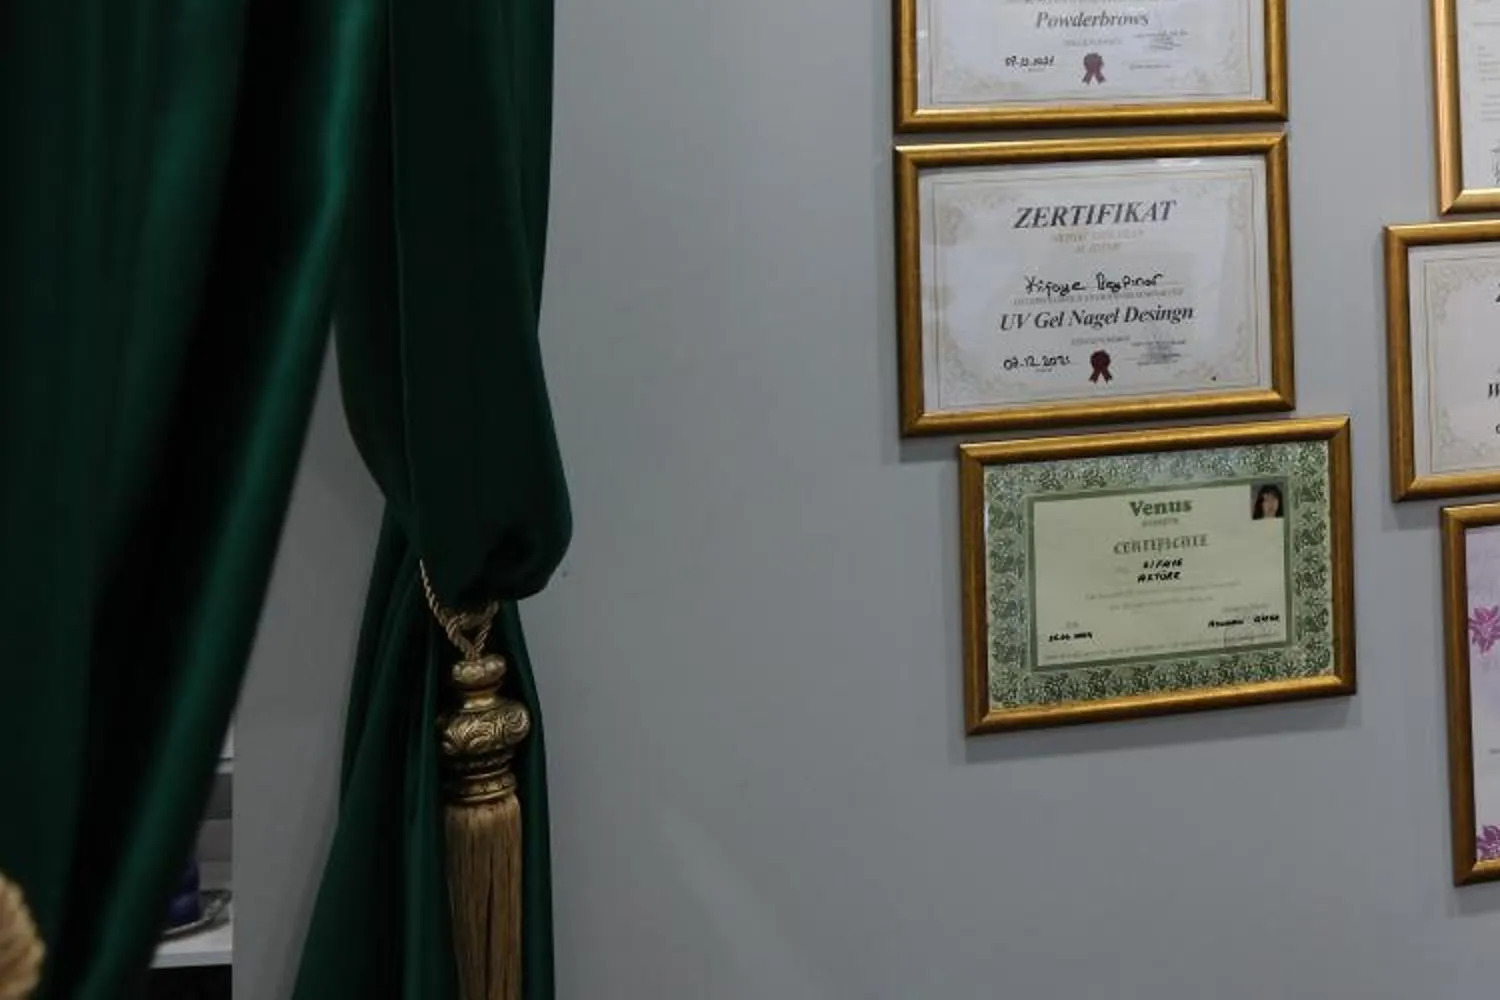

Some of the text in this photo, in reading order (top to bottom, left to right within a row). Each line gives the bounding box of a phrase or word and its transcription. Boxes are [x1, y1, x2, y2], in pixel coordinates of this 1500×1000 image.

[1036, 11, 1149, 29] Powderbrows
[1013, 200, 1178, 229] ZERTIFIKAT
[1000, 304, 1194, 331] UV Gel Nagel Desingn
[1129, 499, 1192, 517] Venus
